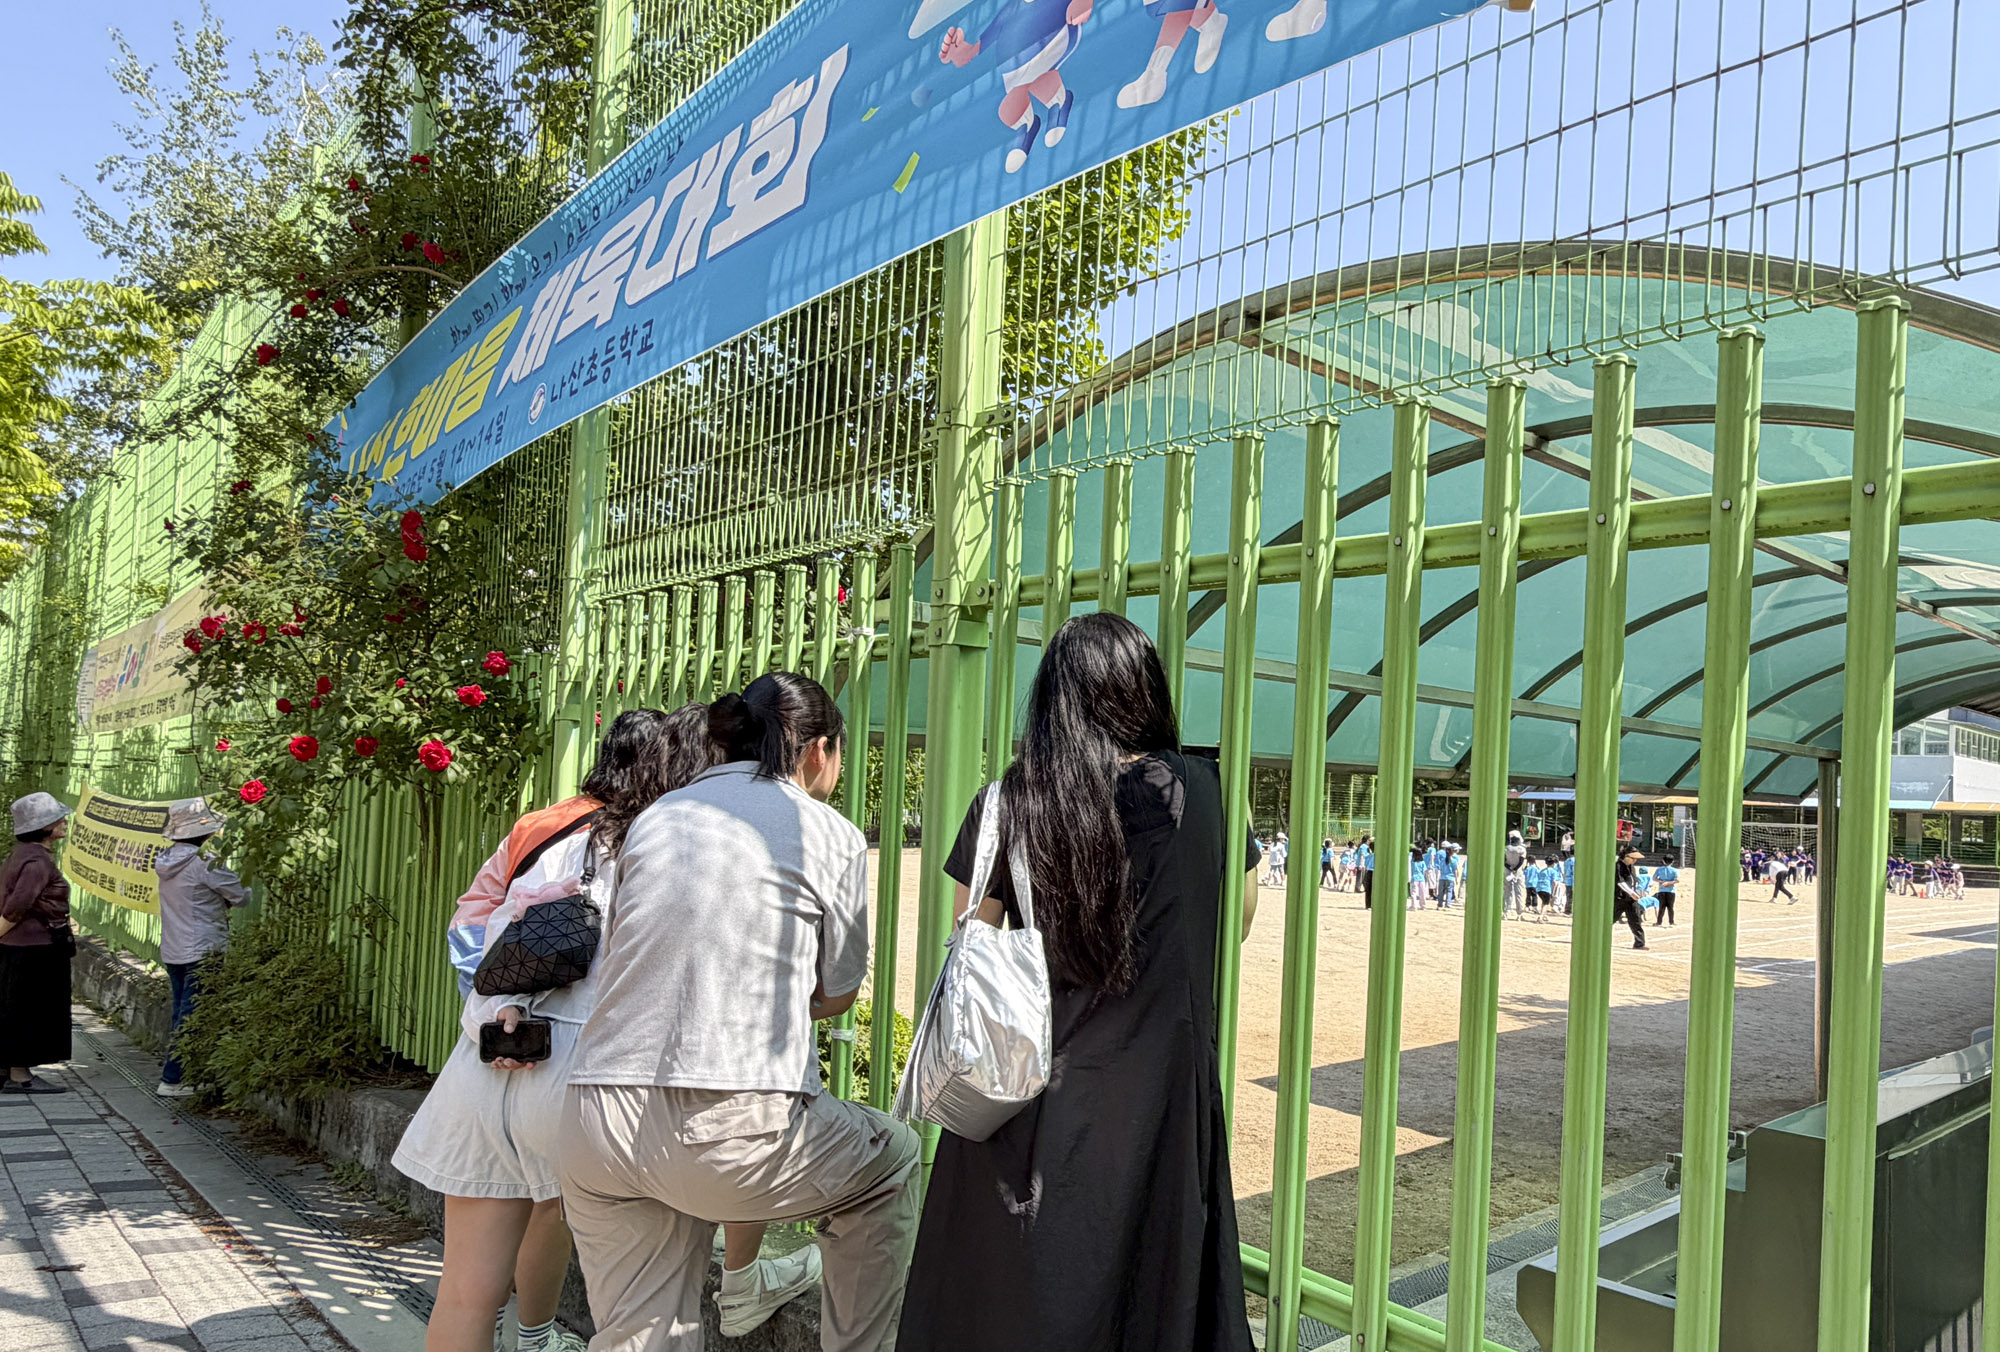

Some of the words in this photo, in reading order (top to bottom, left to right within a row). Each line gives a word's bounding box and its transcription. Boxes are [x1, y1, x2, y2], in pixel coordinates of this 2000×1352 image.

[495, 43, 850, 398] 체육대회
[550, 318, 654, 403] 나산초등학교
[450, 405, 509, 469] 12~14일
